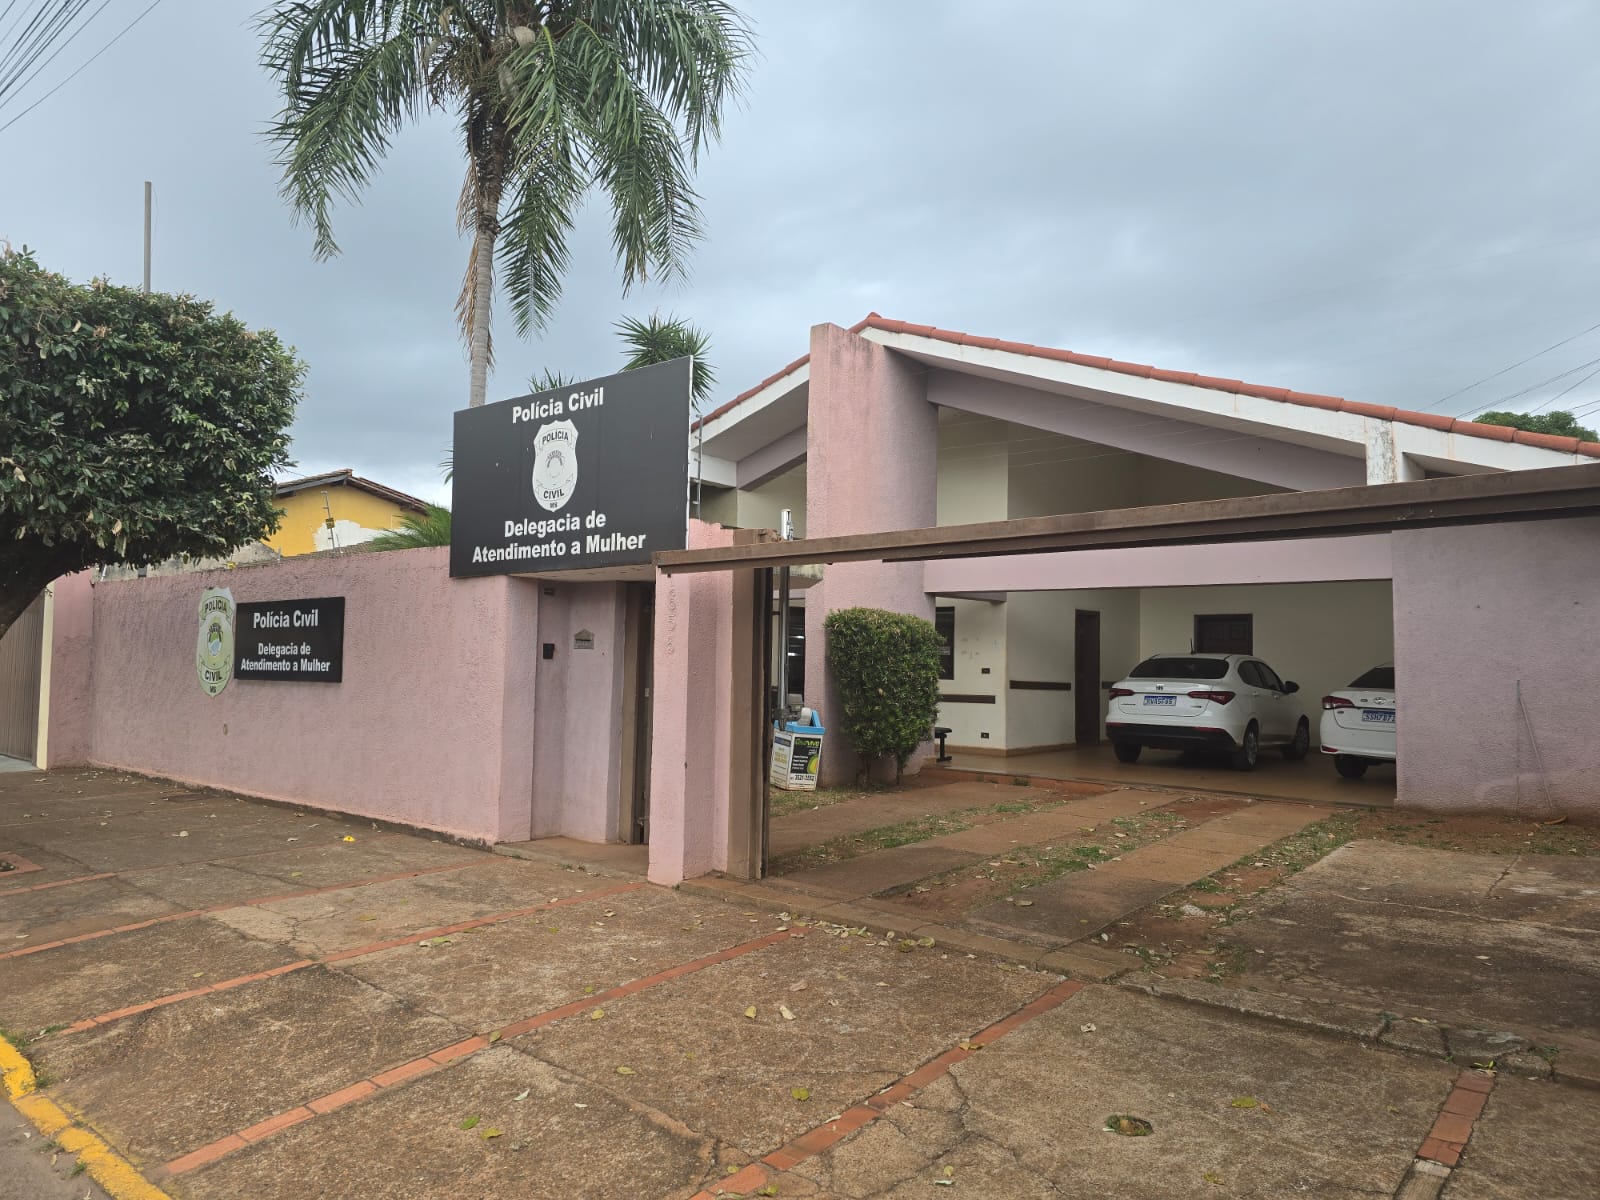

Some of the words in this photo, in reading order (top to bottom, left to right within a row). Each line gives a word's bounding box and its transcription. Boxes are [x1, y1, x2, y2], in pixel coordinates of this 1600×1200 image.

[512, 399, 563, 423] Polícia
[568, 387, 604, 410] Civil
[544, 489, 564, 499] CIVIL
[504, 514, 580, 538] Delegacia
[586, 511, 607, 528] de
[472, 540, 566, 563] Atendimento
[571, 542, 580, 555] a
[586, 532, 646, 553] Mulher
[254, 612, 289, 628] Polícia
[293, 609, 318, 627] Civil
[258, 643, 297, 657] Delegacia
[300, 642, 311, 655] de
[241, 658, 290, 671] Atendimento
[293, 662, 297, 671] a
[301, 658, 330, 672] Mulher
[205, 671, 222, 680] CIVIL
